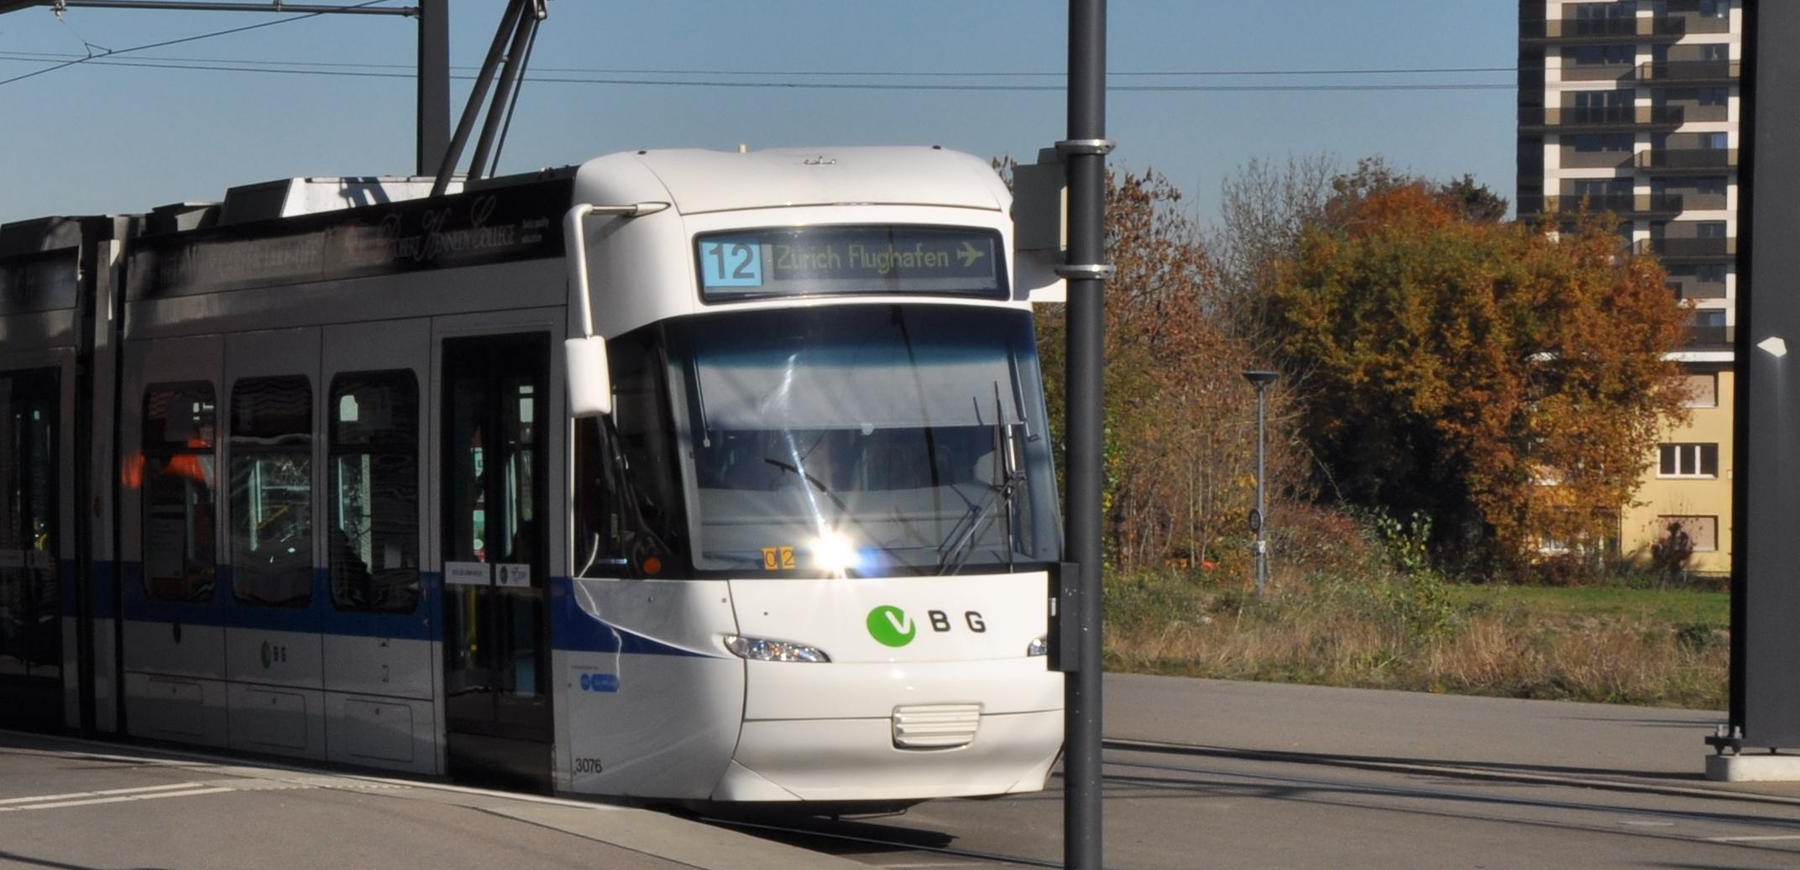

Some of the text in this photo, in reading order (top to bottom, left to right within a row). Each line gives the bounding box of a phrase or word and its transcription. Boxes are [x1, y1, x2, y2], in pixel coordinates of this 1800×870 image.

[709, 242, 756, 280] 12
[849, 244, 949, 274] Flughafen
[575, 757, 604, 774] 3076
